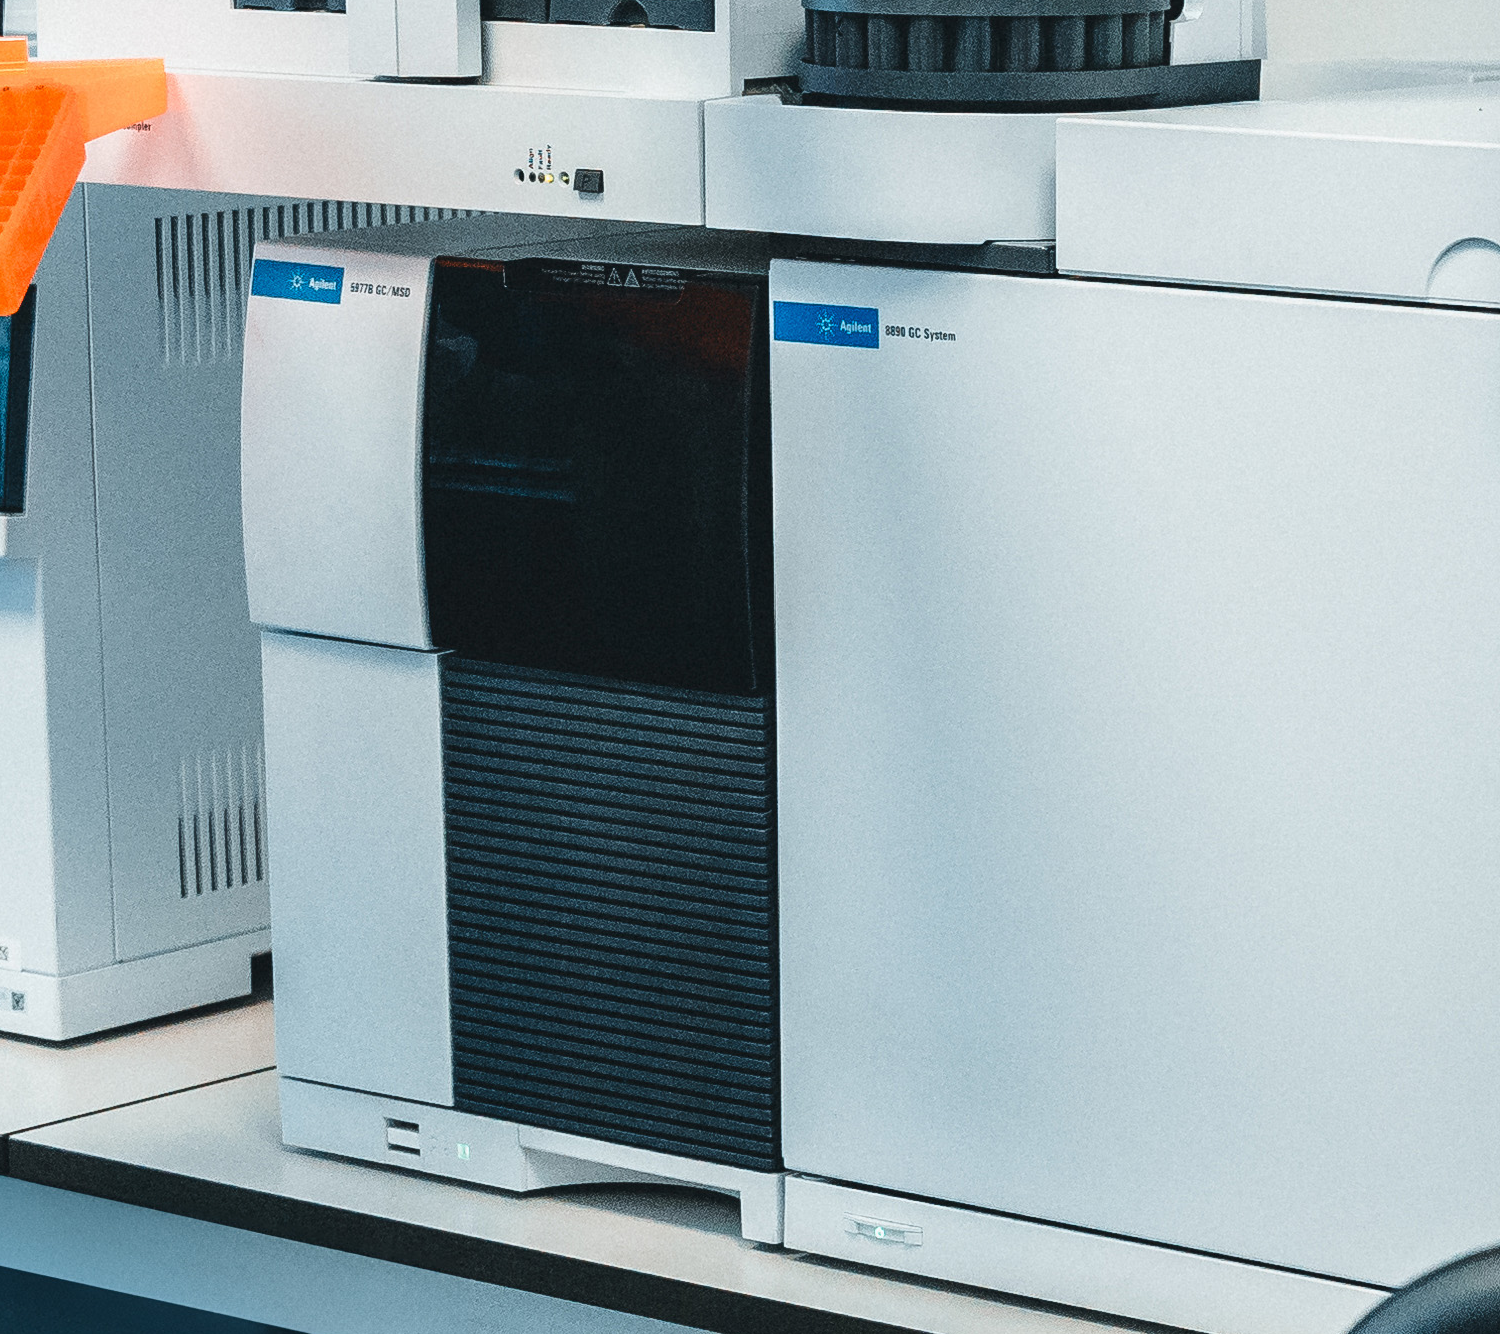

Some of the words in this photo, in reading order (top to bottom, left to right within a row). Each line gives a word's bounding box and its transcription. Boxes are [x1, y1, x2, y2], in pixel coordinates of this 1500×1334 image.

[308, 277, 337, 291] Agilent
[375, 284, 411, 298] GC/MSD
[839, 319, 872, 335] Agilent
[885, 324, 906, 337] 8890
[908, 326, 922, 339] GC
[923, 328, 957, 342] System
